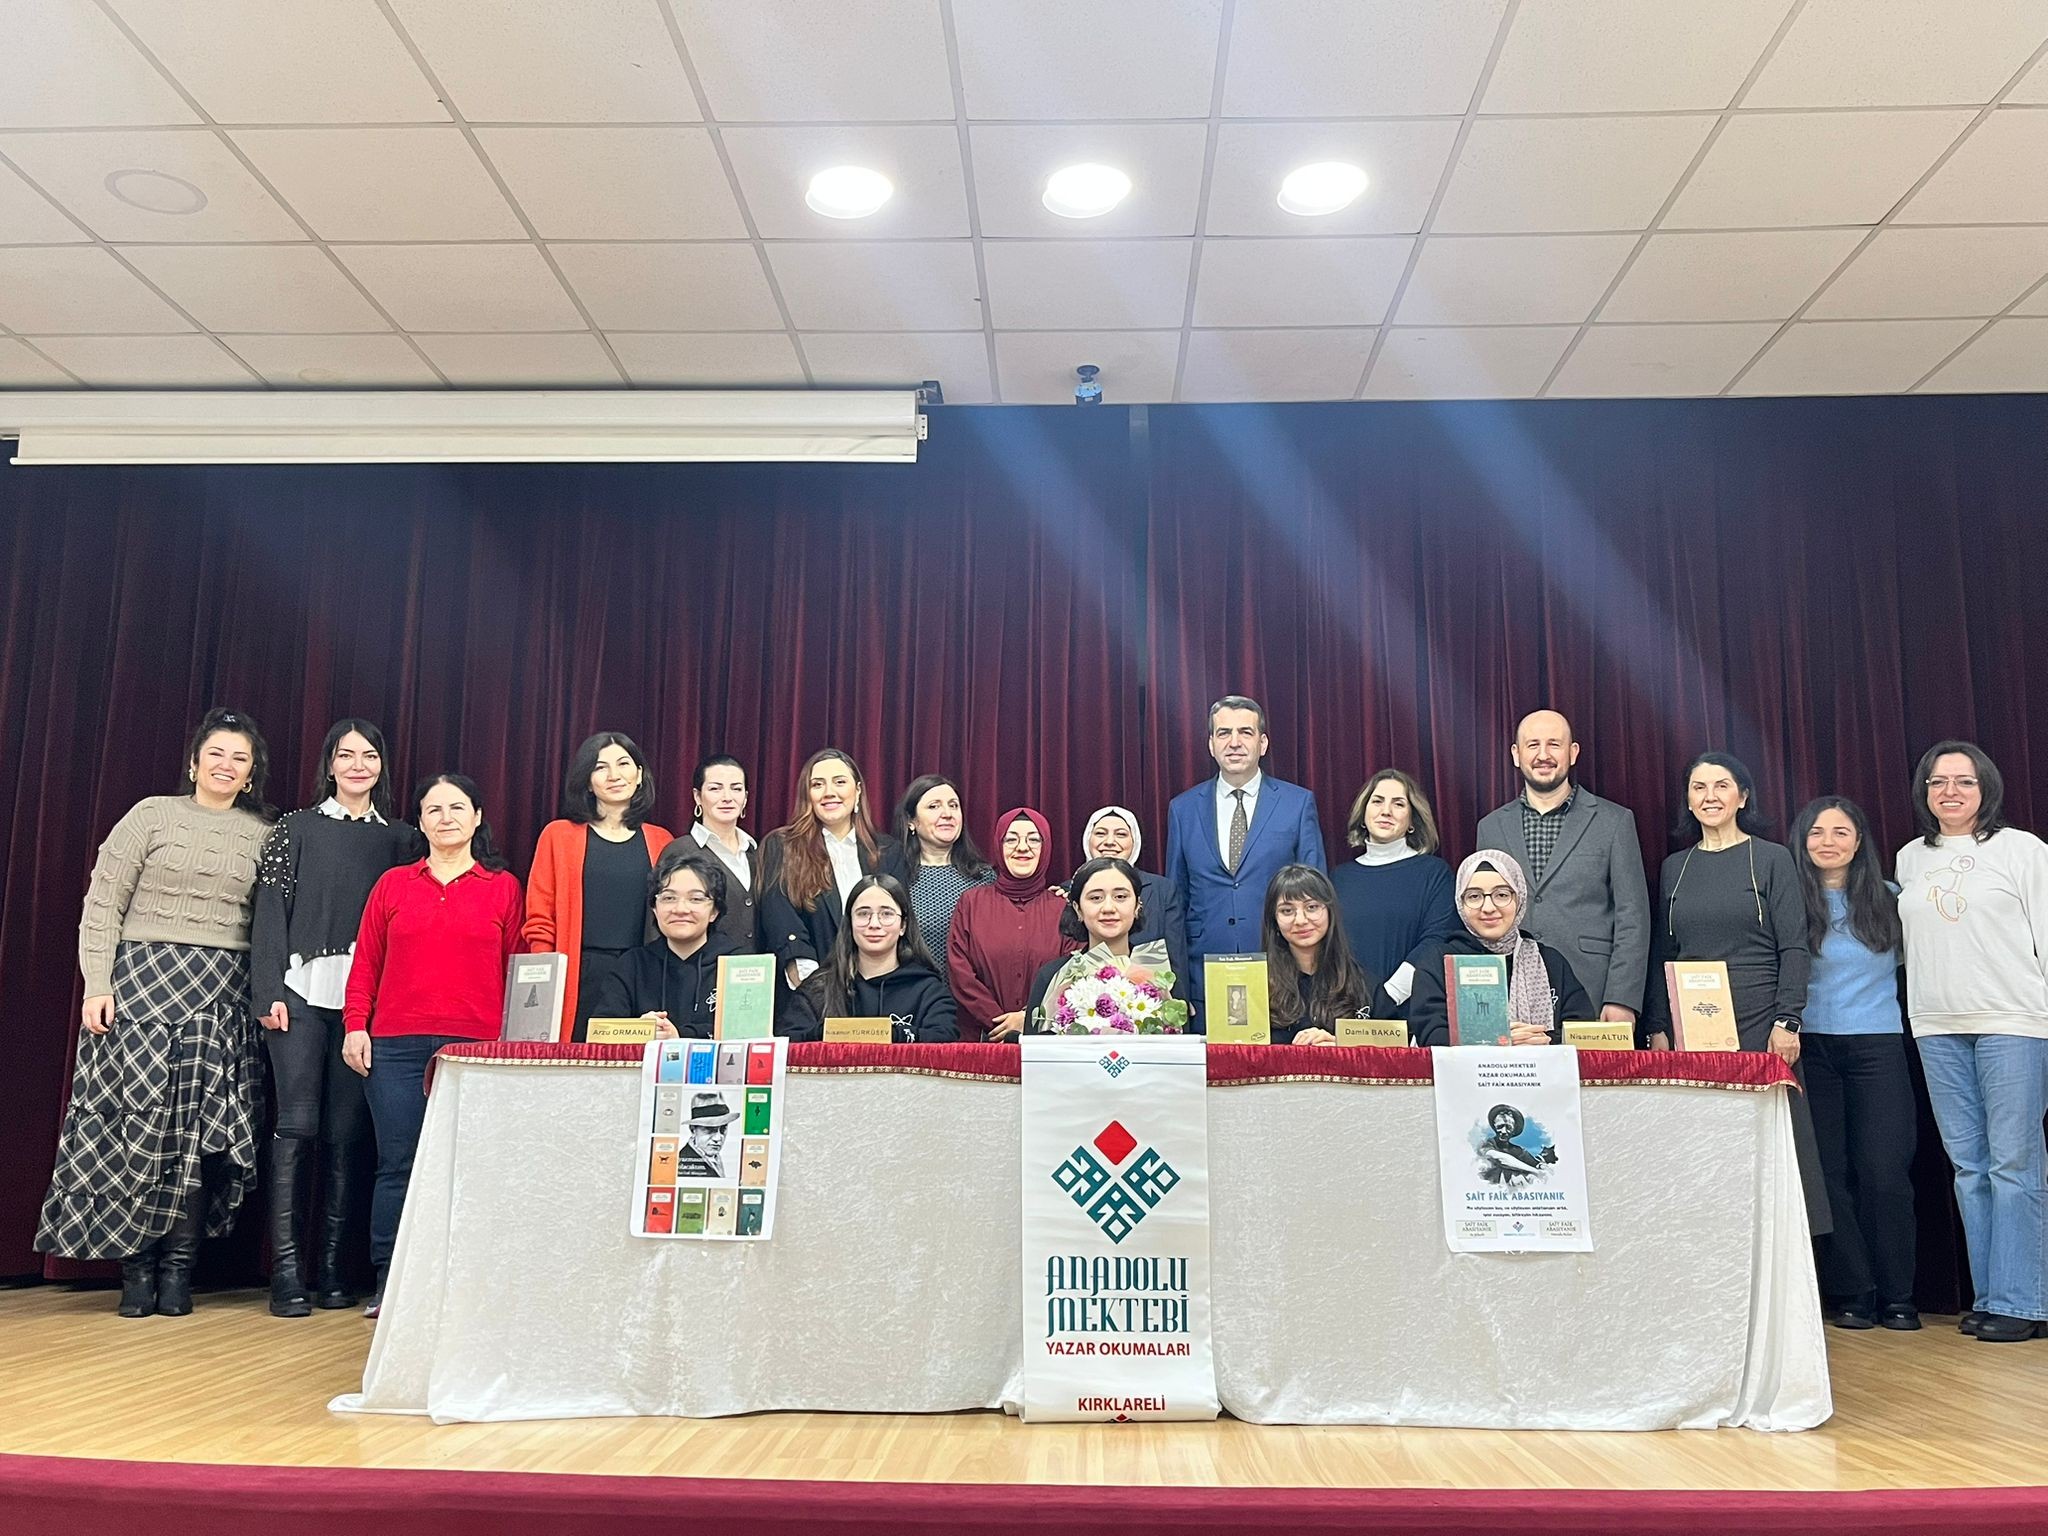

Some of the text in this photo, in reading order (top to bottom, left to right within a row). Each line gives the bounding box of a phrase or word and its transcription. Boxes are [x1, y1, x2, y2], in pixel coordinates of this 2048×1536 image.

[592, 1028, 611, 1036] Arzu
[1345, 1028, 1401, 1037] Damla BAKAÇ
[1569, 1033, 1600, 1041] Nisanur
[1465, 1191, 1566, 1201] SAİT FAİK ABASIYANIK
[1045, 1255, 1189, 1296] ANADOLU
[1045, 1294, 1190, 1338] MEKTEBİ
[1046, 1342, 1191, 1356] YAZAR OKUMALARI
[1078, 1395, 1166, 1411] KIRKLARELİ
